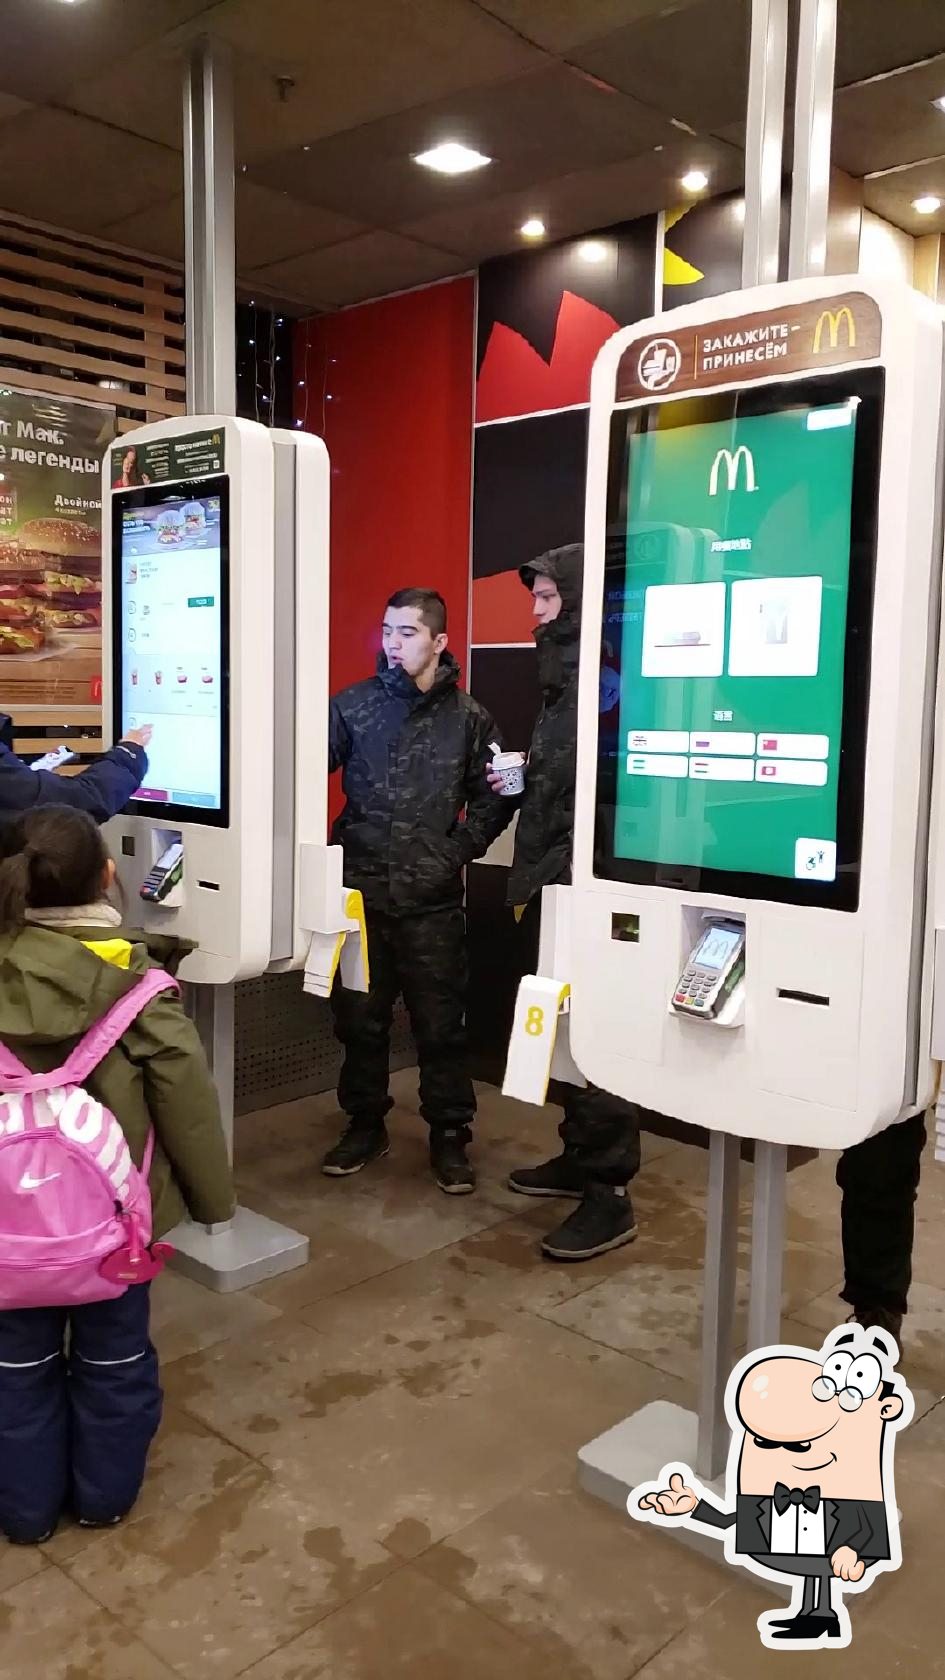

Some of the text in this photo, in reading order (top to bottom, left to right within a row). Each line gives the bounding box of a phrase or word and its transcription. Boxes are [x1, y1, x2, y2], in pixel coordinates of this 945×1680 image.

[703, 342, 788, 371] ПРИНЕСЁМ
[17, 420, 65, 445] Мак.
[10, 447, 100, 474] легенды
[54, 494, 102, 509] Двойной
[525, 1006, 544, 1036] 8
